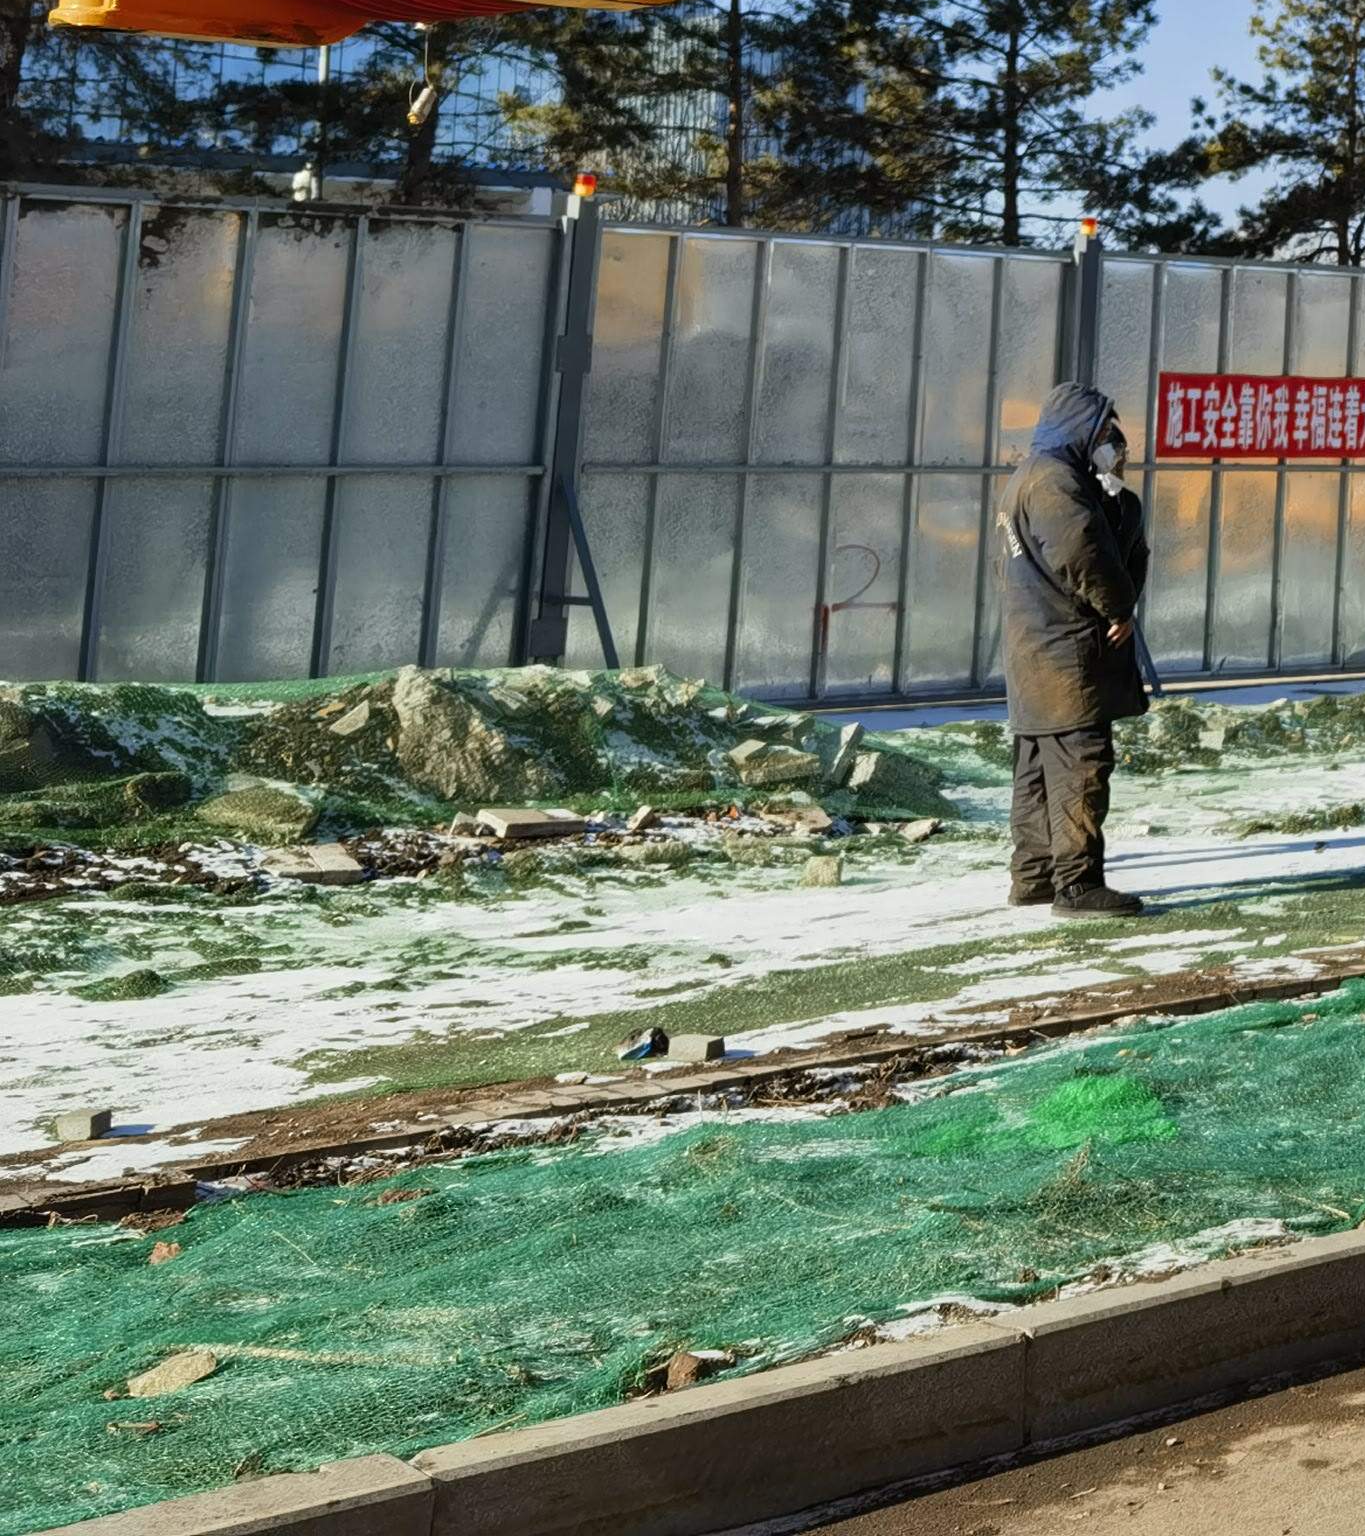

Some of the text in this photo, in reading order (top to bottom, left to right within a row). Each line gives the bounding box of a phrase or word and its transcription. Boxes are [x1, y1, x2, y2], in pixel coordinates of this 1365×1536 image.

[1165, 381, 1289, 450] 施工安全靠你我
